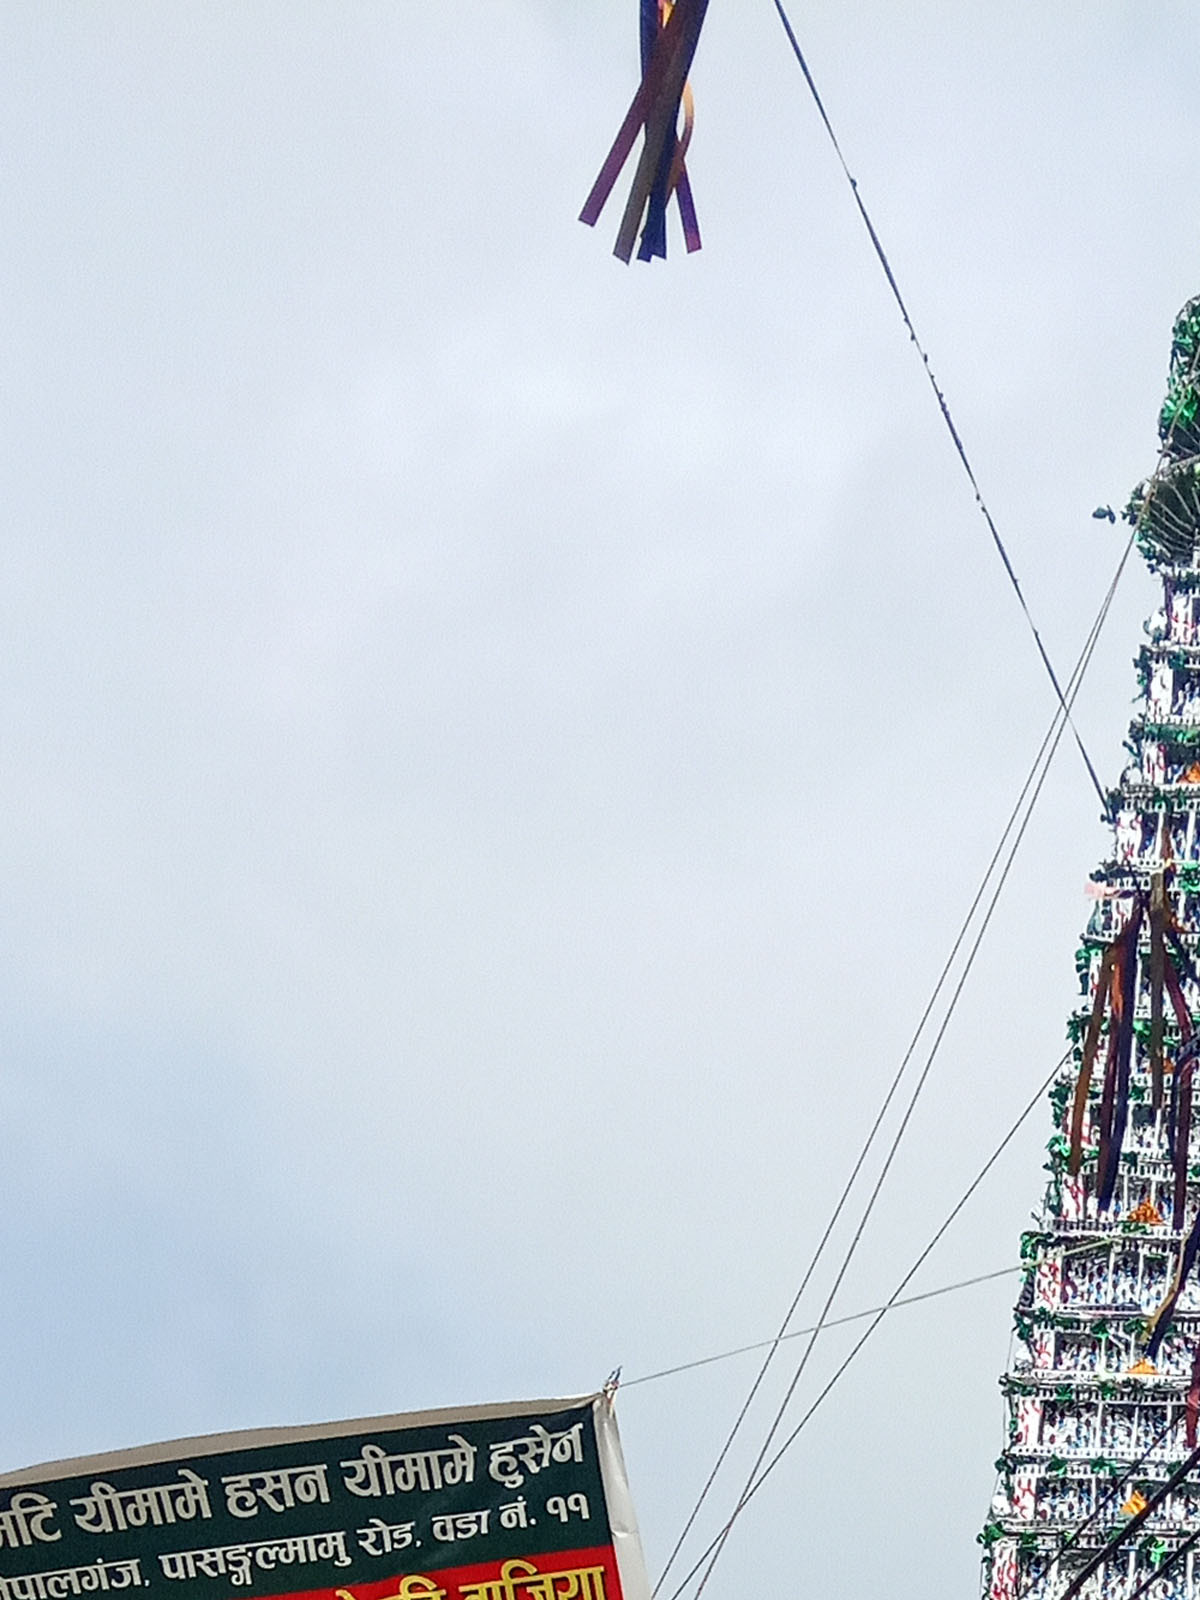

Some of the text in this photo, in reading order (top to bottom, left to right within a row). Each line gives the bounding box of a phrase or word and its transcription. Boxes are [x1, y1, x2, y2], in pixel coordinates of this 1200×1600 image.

[69, 1468, 213, 1535] यीमामे
[221, 1464, 331, 1519] हसन
[340, 1434, 478, 1498] यीमामे
[489, 1422, 584, 1489] हुसेन
[432, 1509, 491, 1542] वडा
[546, 1493, 590, 1524] ११
